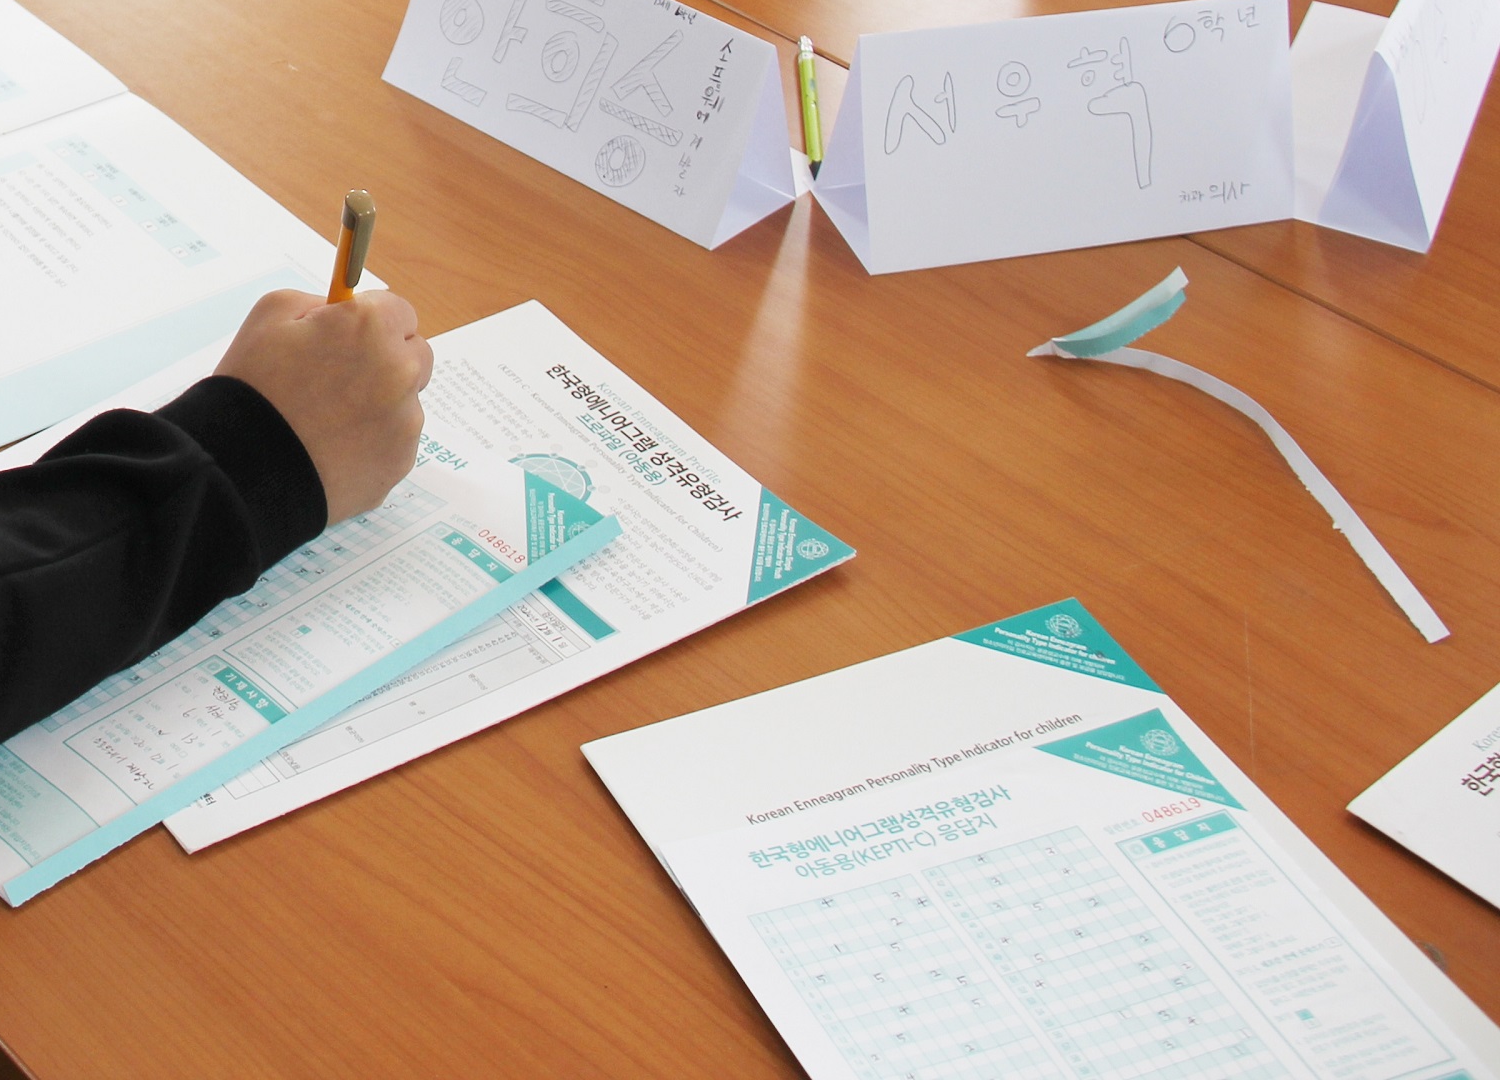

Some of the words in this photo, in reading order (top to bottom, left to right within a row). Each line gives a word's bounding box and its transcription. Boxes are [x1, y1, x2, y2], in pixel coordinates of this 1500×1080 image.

[884, 36, 1153, 190] 서우혁
[1208, 181, 1251, 201] 의사
[545, 363, 658, 452] 한국형에니어그램
[648, 448, 743, 523] 성격유형검사
[574, 411, 625, 452] 프로파일
[618, 448, 667, 486] (아동용)
[596, 381, 633, 412] Korean
[630, 409, 687, 458] Enneagram
[685, 455, 722, 485] Profile
[477, 529, 525, 564] 048618
[745, 804, 795, 827] Korean
[795, 781, 866, 813] Enneagram
[866, 758, 932, 791] Personality
[930, 746, 961, 773] Type
[961, 736, 1013, 761] Indicator
[1013, 727, 1034, 747] for
[1034, 712, 1083, 741] children
[747, 784, 1012, 870] 한국형에니어그램성격유형검사
[795, 829, 937, 881] 아동용(KEPTI-C)
[939, 812, 998, 843] 응답지
[1142, 797, 1202, 823] 048619
